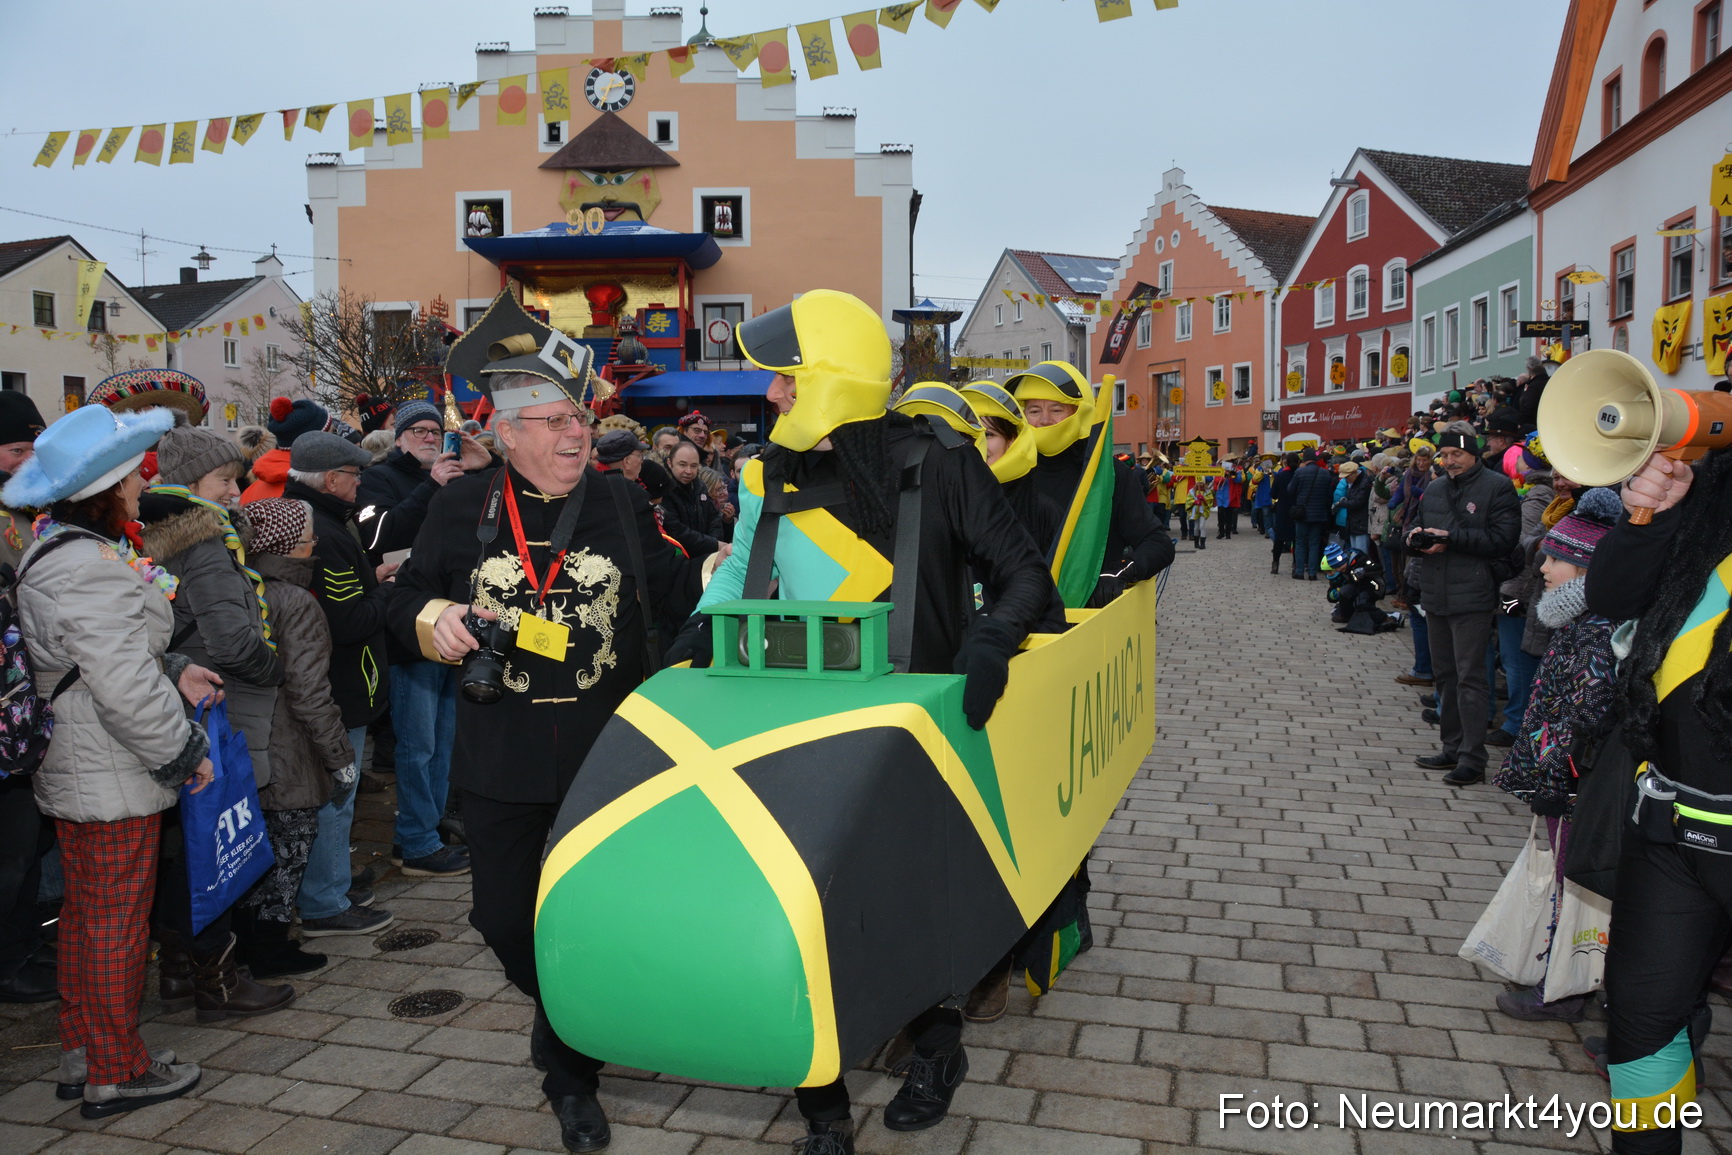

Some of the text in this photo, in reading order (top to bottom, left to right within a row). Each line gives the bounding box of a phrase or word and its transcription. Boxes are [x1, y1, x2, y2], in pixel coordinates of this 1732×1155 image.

[566, 207, 605, 235] 90
[1263, 411, 1278, 420] CAFÉ
[1601, 412, 1617, 424] RCS
[487, 490, 501, 519] Canon
[1057, 633, 1144, 817] JAMAICA
[230, 842, 246, 857] KLIER
[246, 834, 254, 845] KG
